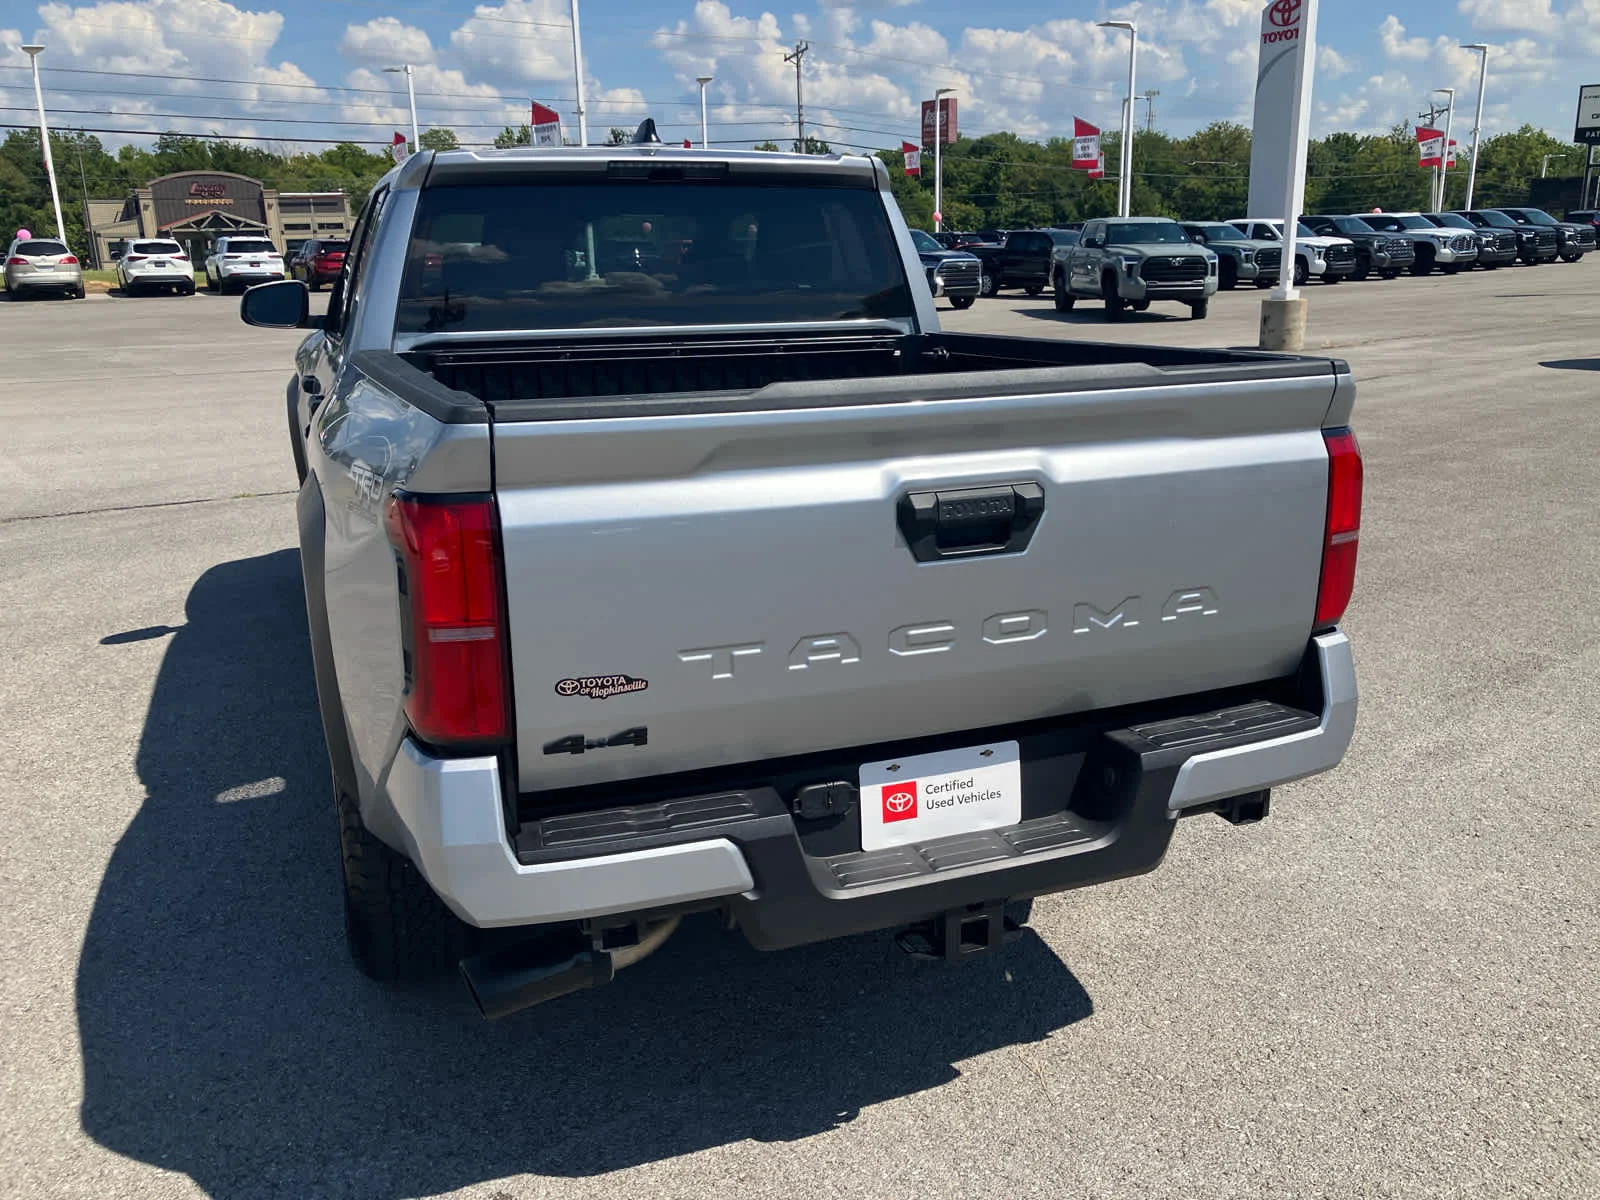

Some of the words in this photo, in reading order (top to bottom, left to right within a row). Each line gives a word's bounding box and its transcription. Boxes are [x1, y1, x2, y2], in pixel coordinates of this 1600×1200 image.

[942, 501, 1012, 518] TOYOTA
[678, 586, 1219, 679] TACOMA
[580, 676, 626, 687] TOYOTA
[590, 680, 647, 697] Hopkinsville
[925, 777, 974, 795] Certified
[926, 796, 954, 810] Used
[957, 789, 1001, 805] Vehicles
